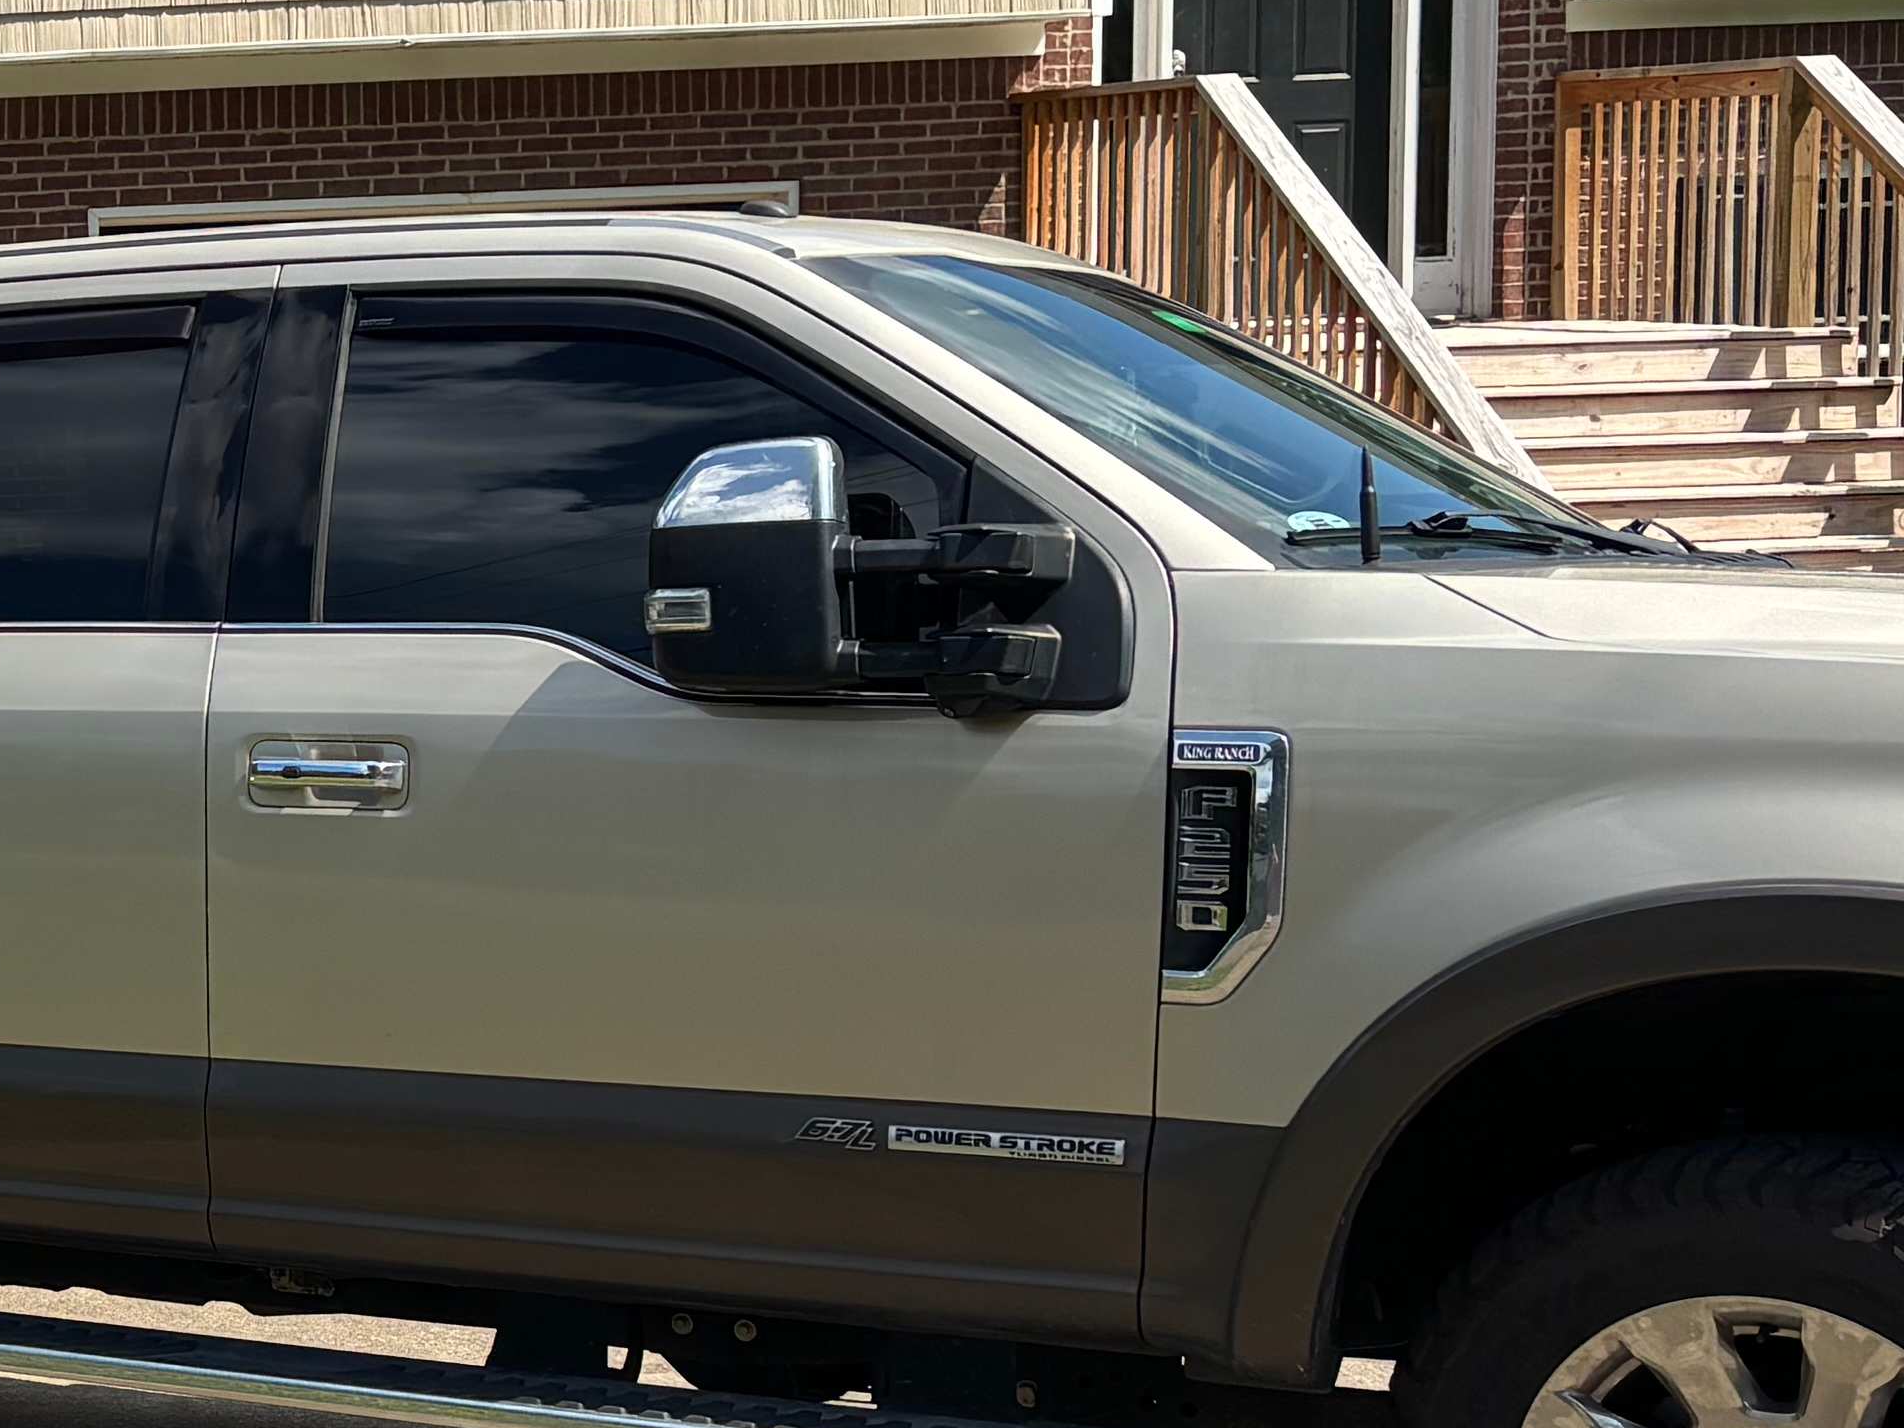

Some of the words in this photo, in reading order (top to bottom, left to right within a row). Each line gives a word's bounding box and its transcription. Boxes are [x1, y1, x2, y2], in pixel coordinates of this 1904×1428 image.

[1183, 744, 1212, 760] KING
[1214, 745, 1255, 761] RANCH
[794, 1116, 877, 1151] 6.7L
[895, 1128, 992, 1149] POWER
[999, 1135, 1116, 1156] STROKE
